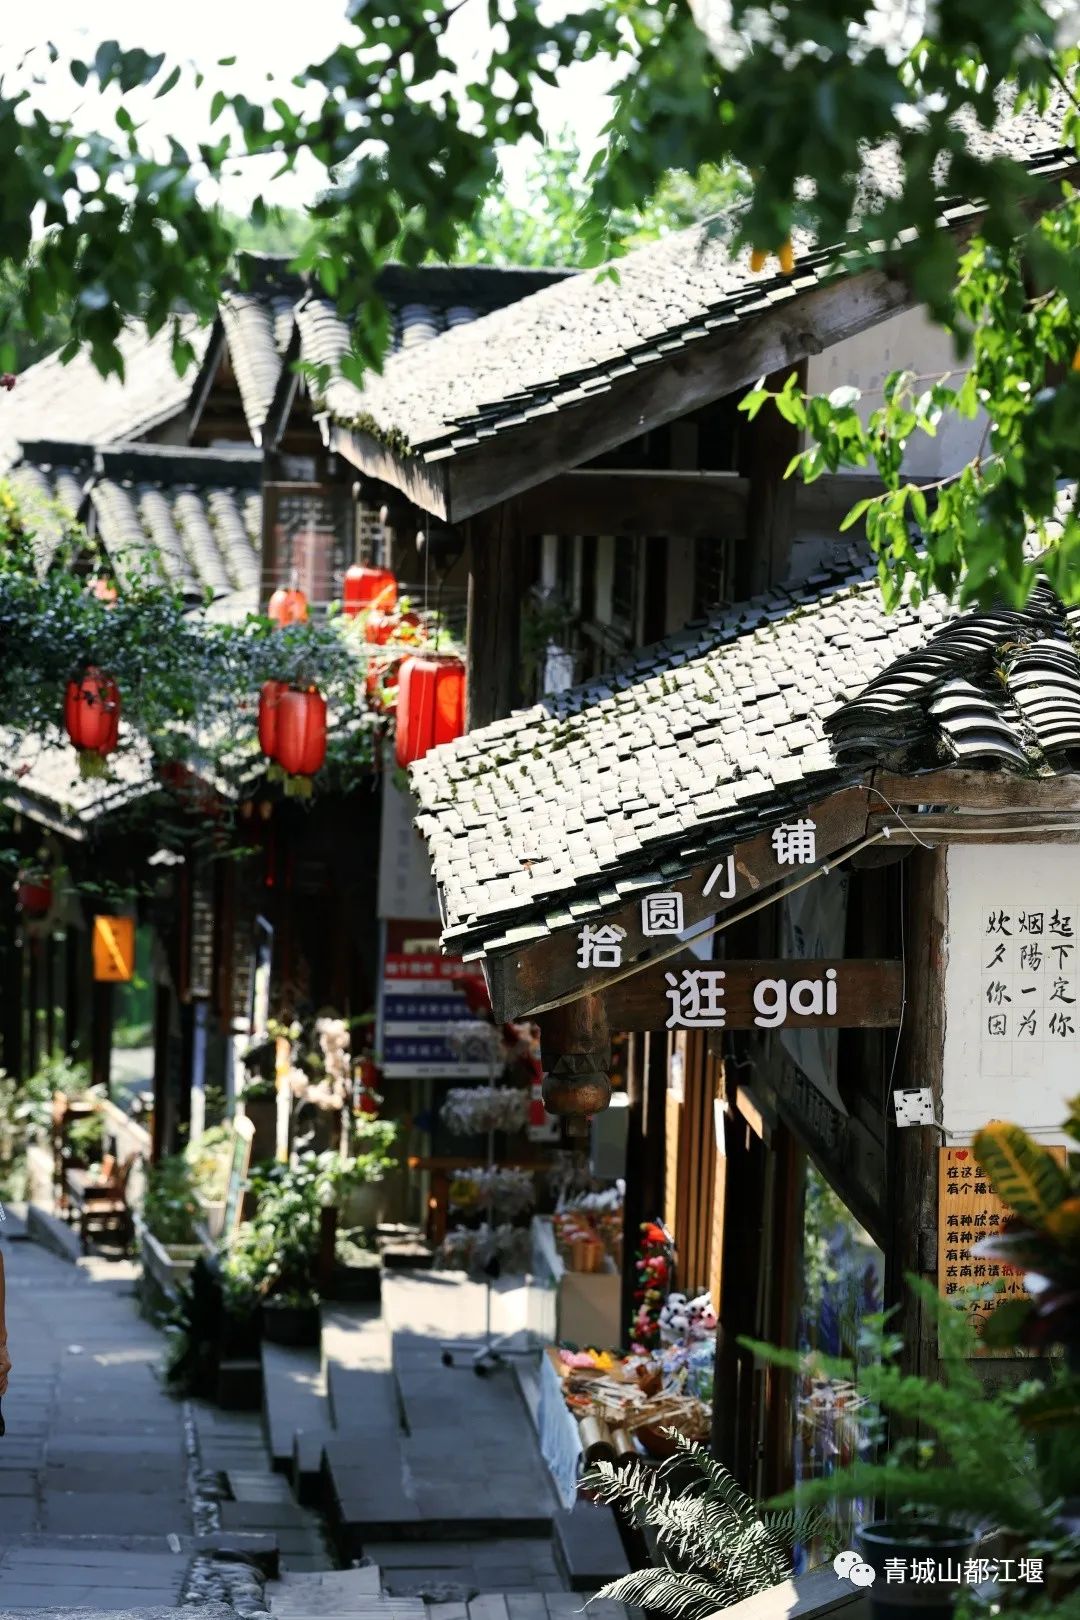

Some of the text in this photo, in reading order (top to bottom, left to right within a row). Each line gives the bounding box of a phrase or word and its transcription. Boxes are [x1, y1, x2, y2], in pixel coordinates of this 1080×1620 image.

[577, 819, 816, 968] 拾圆小铺
[986, 908, 1074, 937] 炊烟起
[665, 968, 837, 1028] 逛 gai
[986, 976, 1076, 1005] 你一定
[988, 1009, 1075, 1037] 因为你
